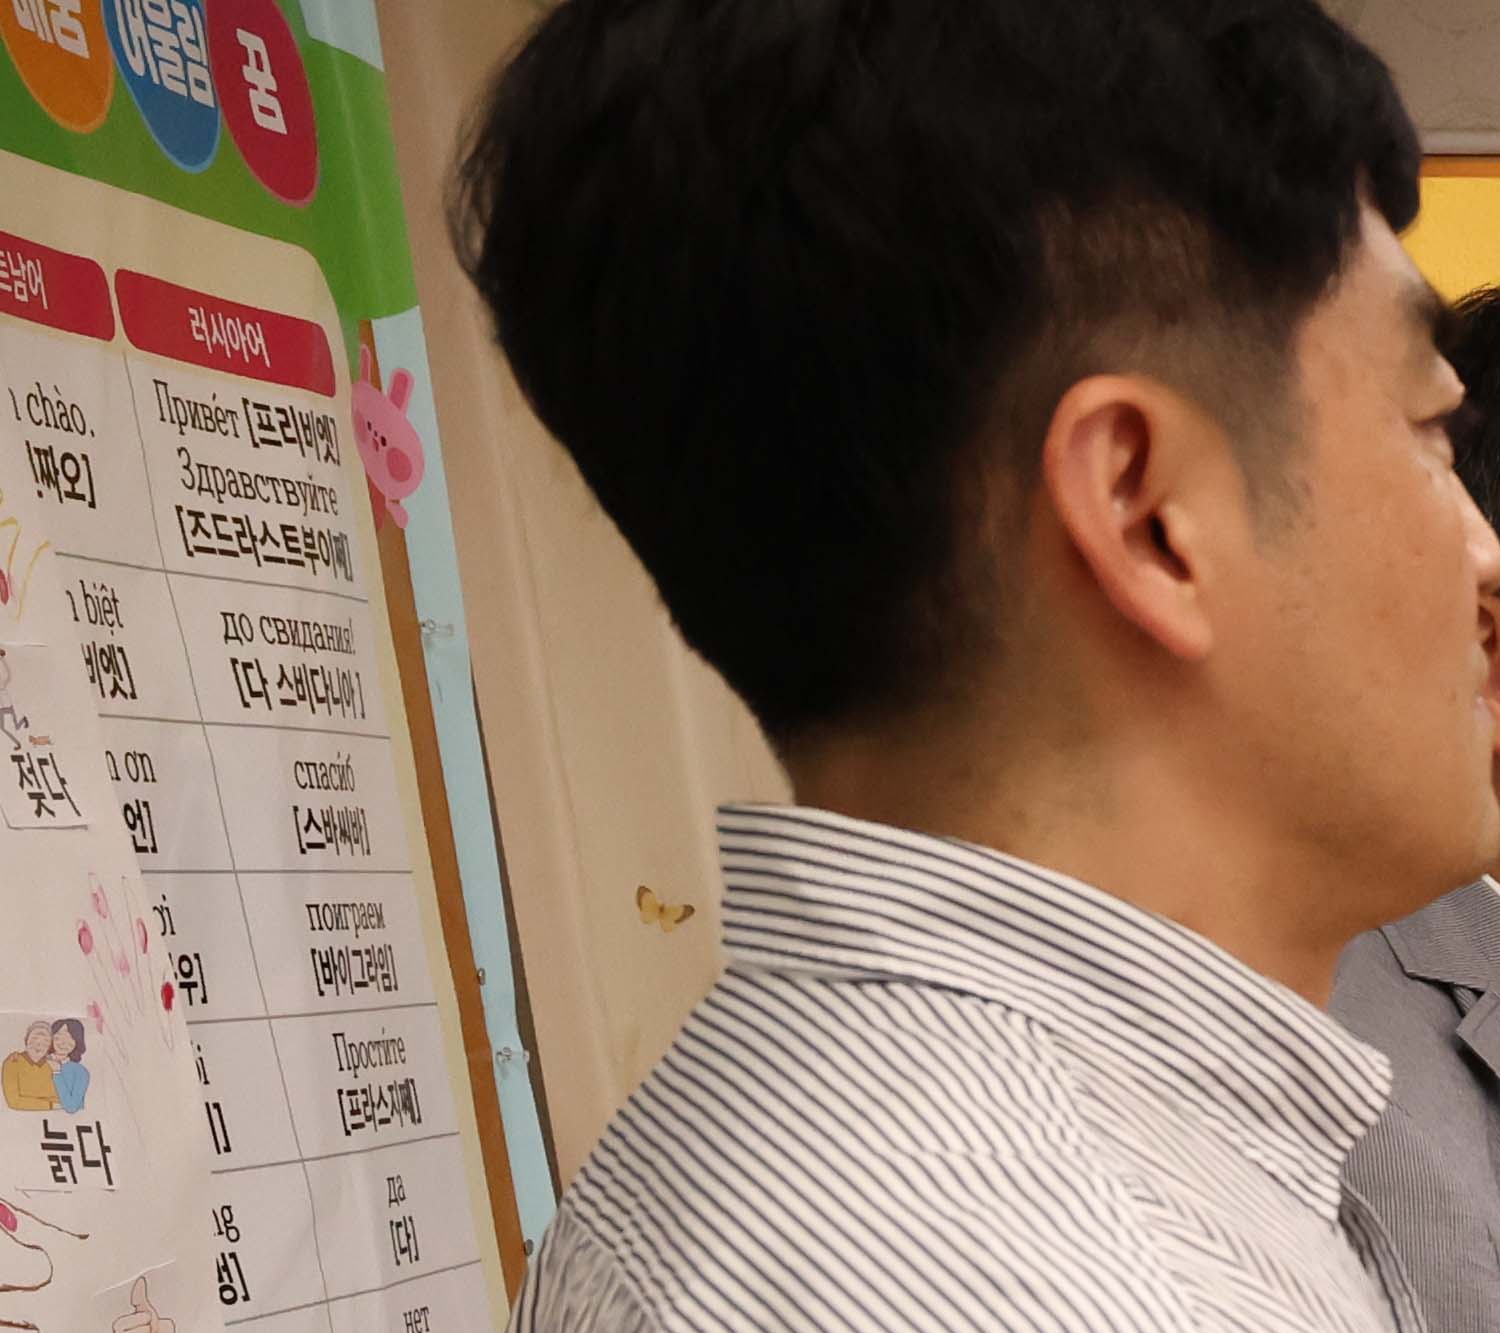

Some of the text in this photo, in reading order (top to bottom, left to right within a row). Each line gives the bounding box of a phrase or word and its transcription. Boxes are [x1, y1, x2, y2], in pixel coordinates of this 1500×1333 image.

[188, 306, 271, 368] 러시아어
[177, 446, 339, 517] Здравствуйте
[219, 611, 254, 645] до
[304, 901, 387, 939] поиграем
[40, 1119, 114, 1185] 늙다
[386, 1174, 407, 1209] да
